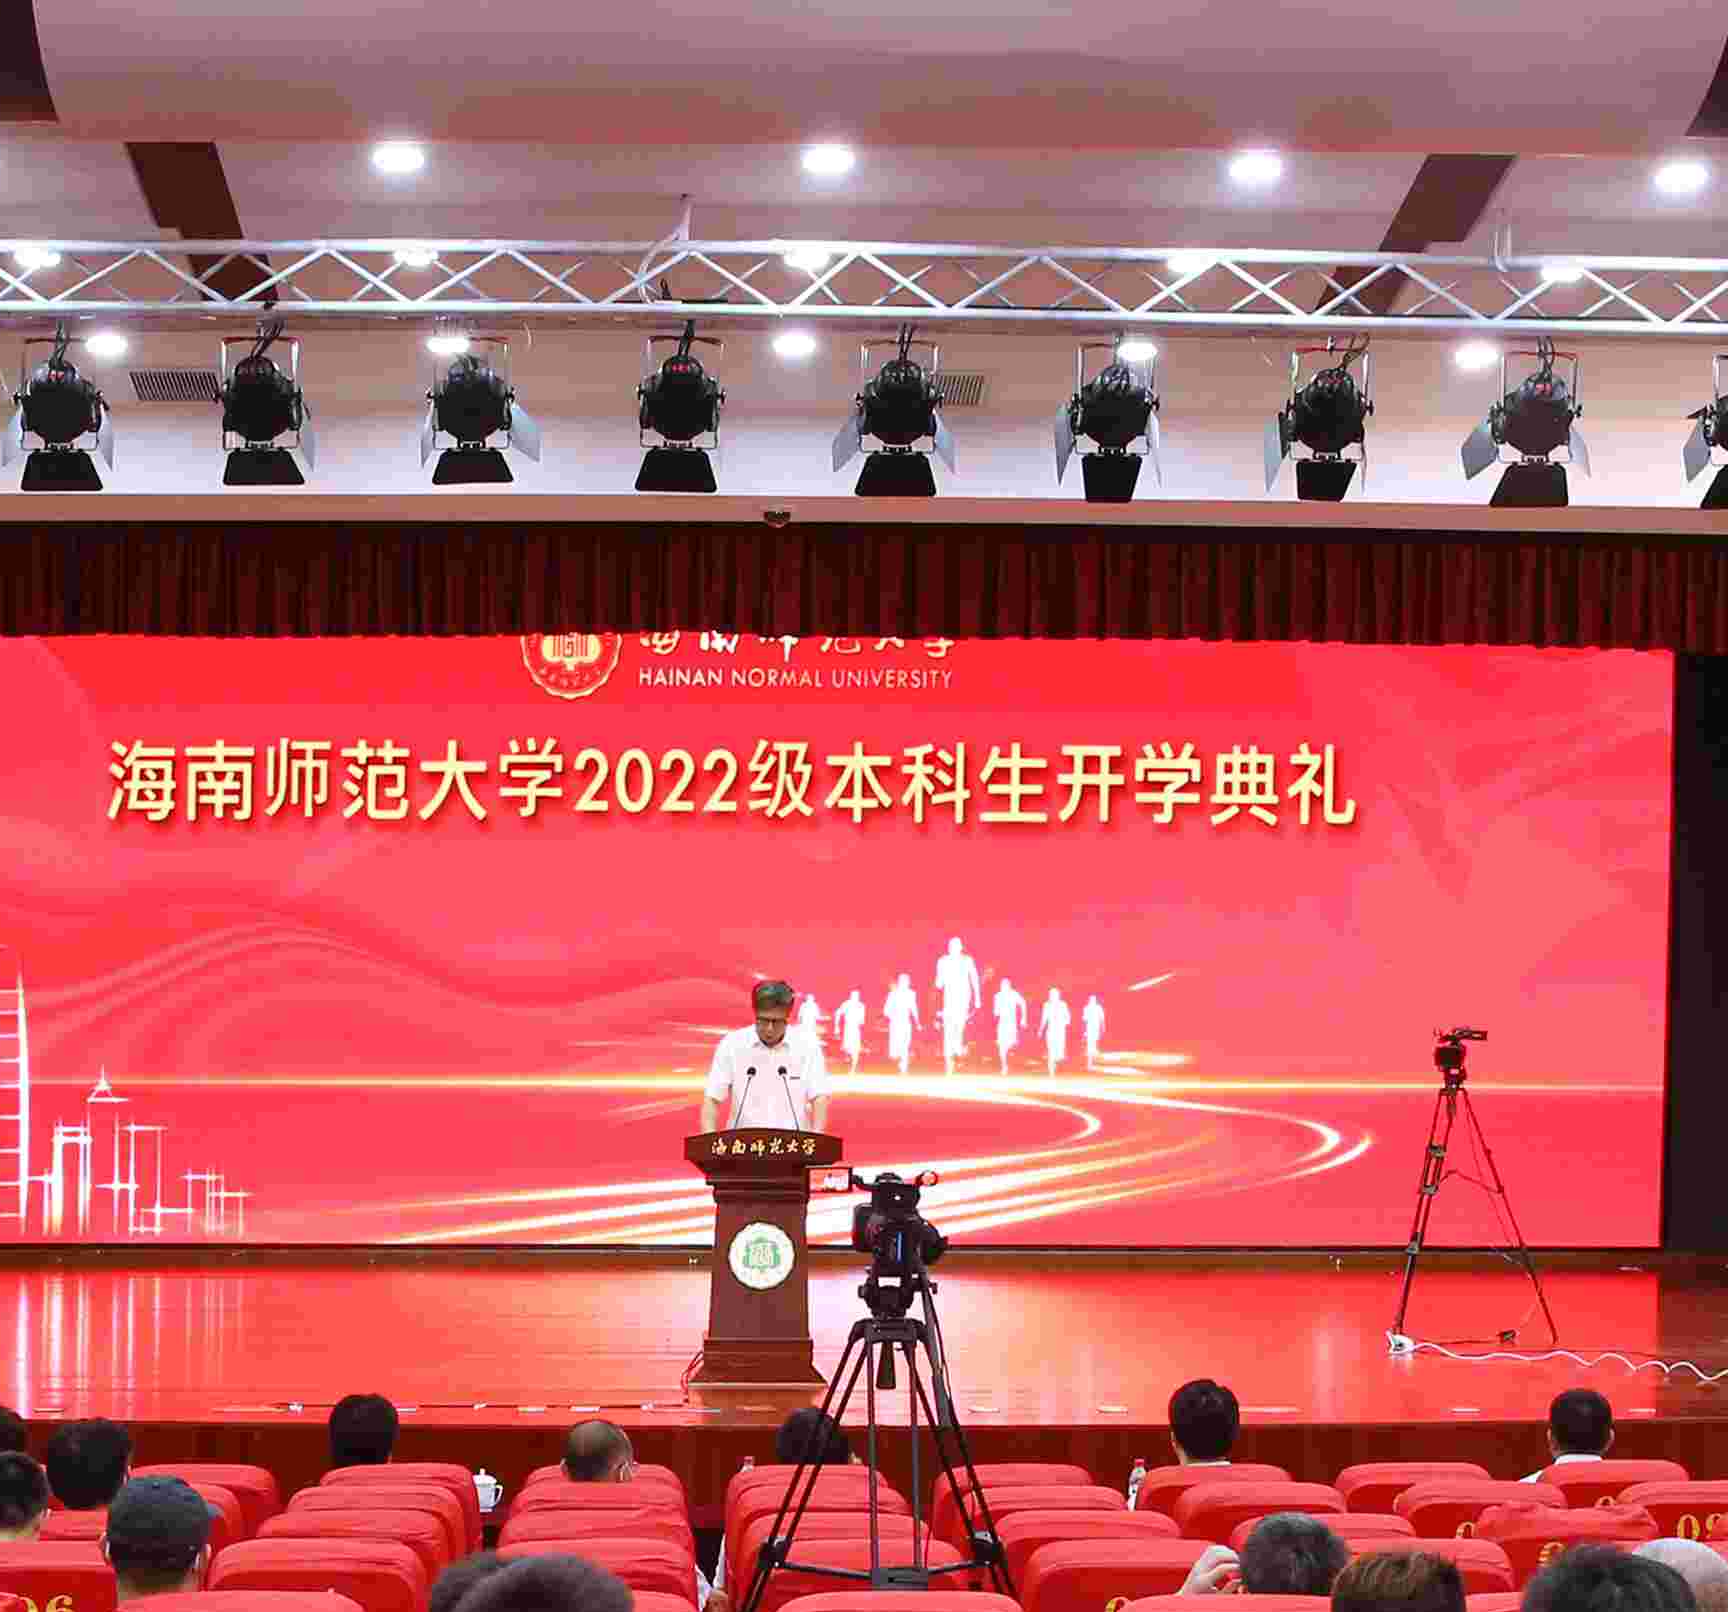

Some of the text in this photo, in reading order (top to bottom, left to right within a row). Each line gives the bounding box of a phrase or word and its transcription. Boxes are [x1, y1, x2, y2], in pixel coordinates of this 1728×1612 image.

[638, 667, 953, 689] HAINAN NORMAL UNIVERSITY
[105, 736, 1358, 826] 海南师范大学2022级本科生开学典礼
